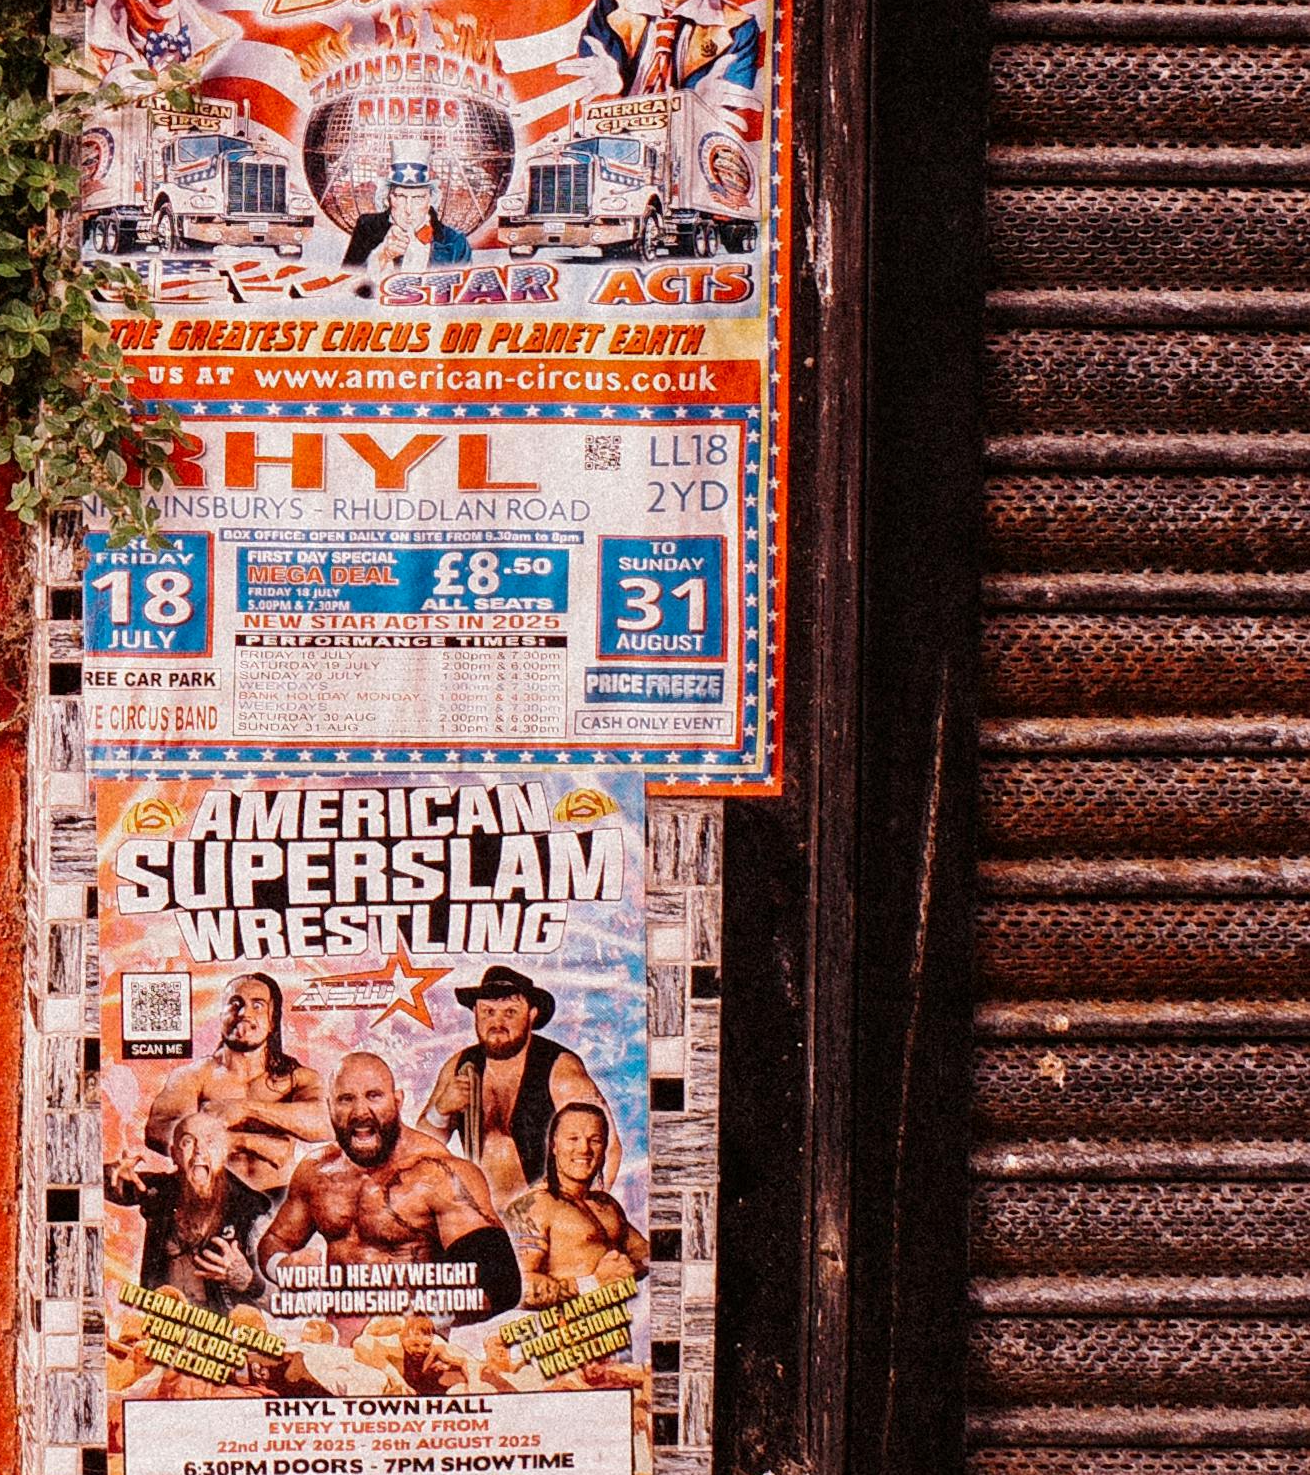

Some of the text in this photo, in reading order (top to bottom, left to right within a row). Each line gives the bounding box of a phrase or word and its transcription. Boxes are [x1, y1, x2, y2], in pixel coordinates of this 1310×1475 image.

[308, 51, 511, 107] THUNDERBALL
[358, 95, 460, 128] RIDERS
[586, 95, 682, 121] AMERICAN
[594, 114, 669, 133] CIRCUS
[380, 262, 559, 307] STAR
[589, 262, 755, 305] ACTS
[110, 318, 163, 350] THE
[168, 320, 316, 352] GREATEST
[321, 321, 431, 353] CIRCUS
[148, 366, 180, 384] US
[194, 366, 234, 384] AT
[254, 363, 718, 392] www.american-circus.co.uk
[121, 430, 541, 493] RHYL
[650, 433, 728, 467] LL18
[647, 480, 729, 514] 2YD
[247, 550, 398, 564] FIRST DAY SPECIAL
[244, 614, 560, 630] NEW STAR ACTS IN 2025
[245, 635, 546, 647] PERFORMANCE TIMES:
[586, 674, 720, 699] PRICE FREEZE
[239, 712, 318, 722] SATURDAY
[344, 712, 377, 723] AUG
[581, 716, 724, 731] CASH ONLY EVENT
[188, 781, 551, 841] AMERICAN
[115, 827, 624, 915] SUPERSLAM
[173, 901, 568, 963] WRESTLING
[131, 1044, 183, 1056] SCAN ME
[276, 1262, 478, 1289] WORLD HEAVYWEIGHT
[271, 1288, 485, 1315] CHAMPIONSHIP ACTION!
[499, 1275, 639, 1344] BEST OF AMERICAN
[118, 1282, 286, 1357] INTERNATIONAL STARS
[521, 1303, 633, 1360] PROFESSIONAL
[141, 1314, 248, 1368] FROM ACROSS
[538, 1328, 630, 1379] WRESTLING!
[144, 1338, 232, 1385] THE GLOBE!
[265, 1398, 493, 1417] RHYL TOWN HALL
[269, 1419, 489, 1434] EVERY TUESDAY FROM
[217, 1440, 258, 1453] 22nd
[262, 1439, 305, 1452] JULY
[313, 1439, 356, 1451] 2025
[371, 1438, 410, 1451] 26th
[416, 1436, 493, 1450] AUGUST
[498, 1435, 541, 1448] 2025
[273, 1458, 363, 1474] DOORS
[383, 1456, 435, 1473] 7PM
[441, 1452, 575, 1472] SHOWTIME
